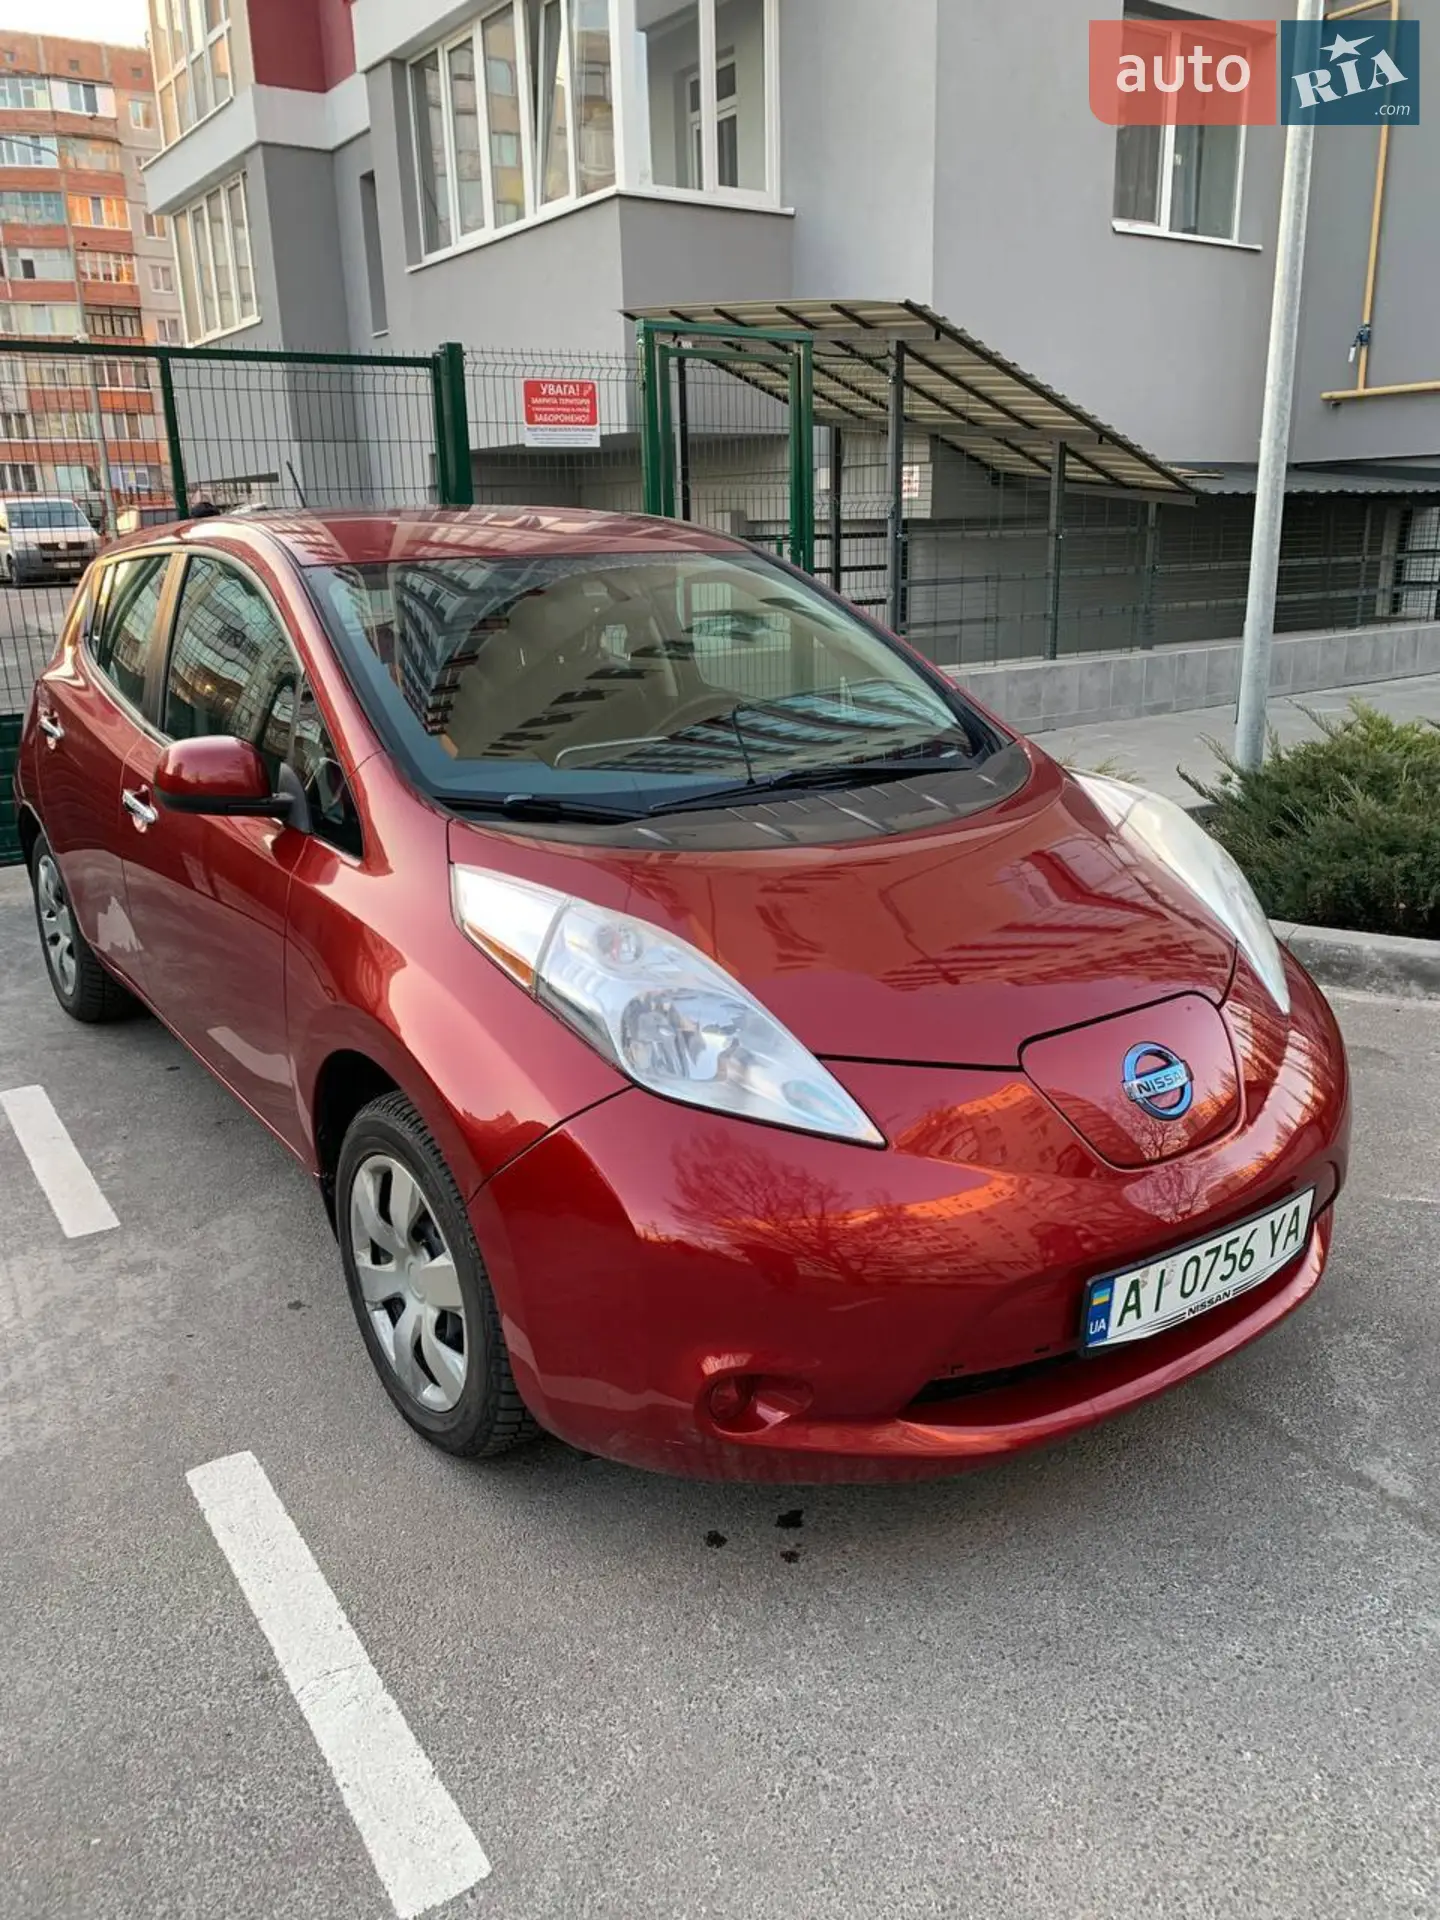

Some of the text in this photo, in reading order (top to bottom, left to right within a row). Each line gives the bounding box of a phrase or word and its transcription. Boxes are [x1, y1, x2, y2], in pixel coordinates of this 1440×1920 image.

[540, 383, 580, 396] УВАГА!
[1117, 1205, 1300, 1327] AI 0756 YA
[1187, 1289, 1232, 1317] NISSAN
[1089, 1318, 1106, 1334] UA
